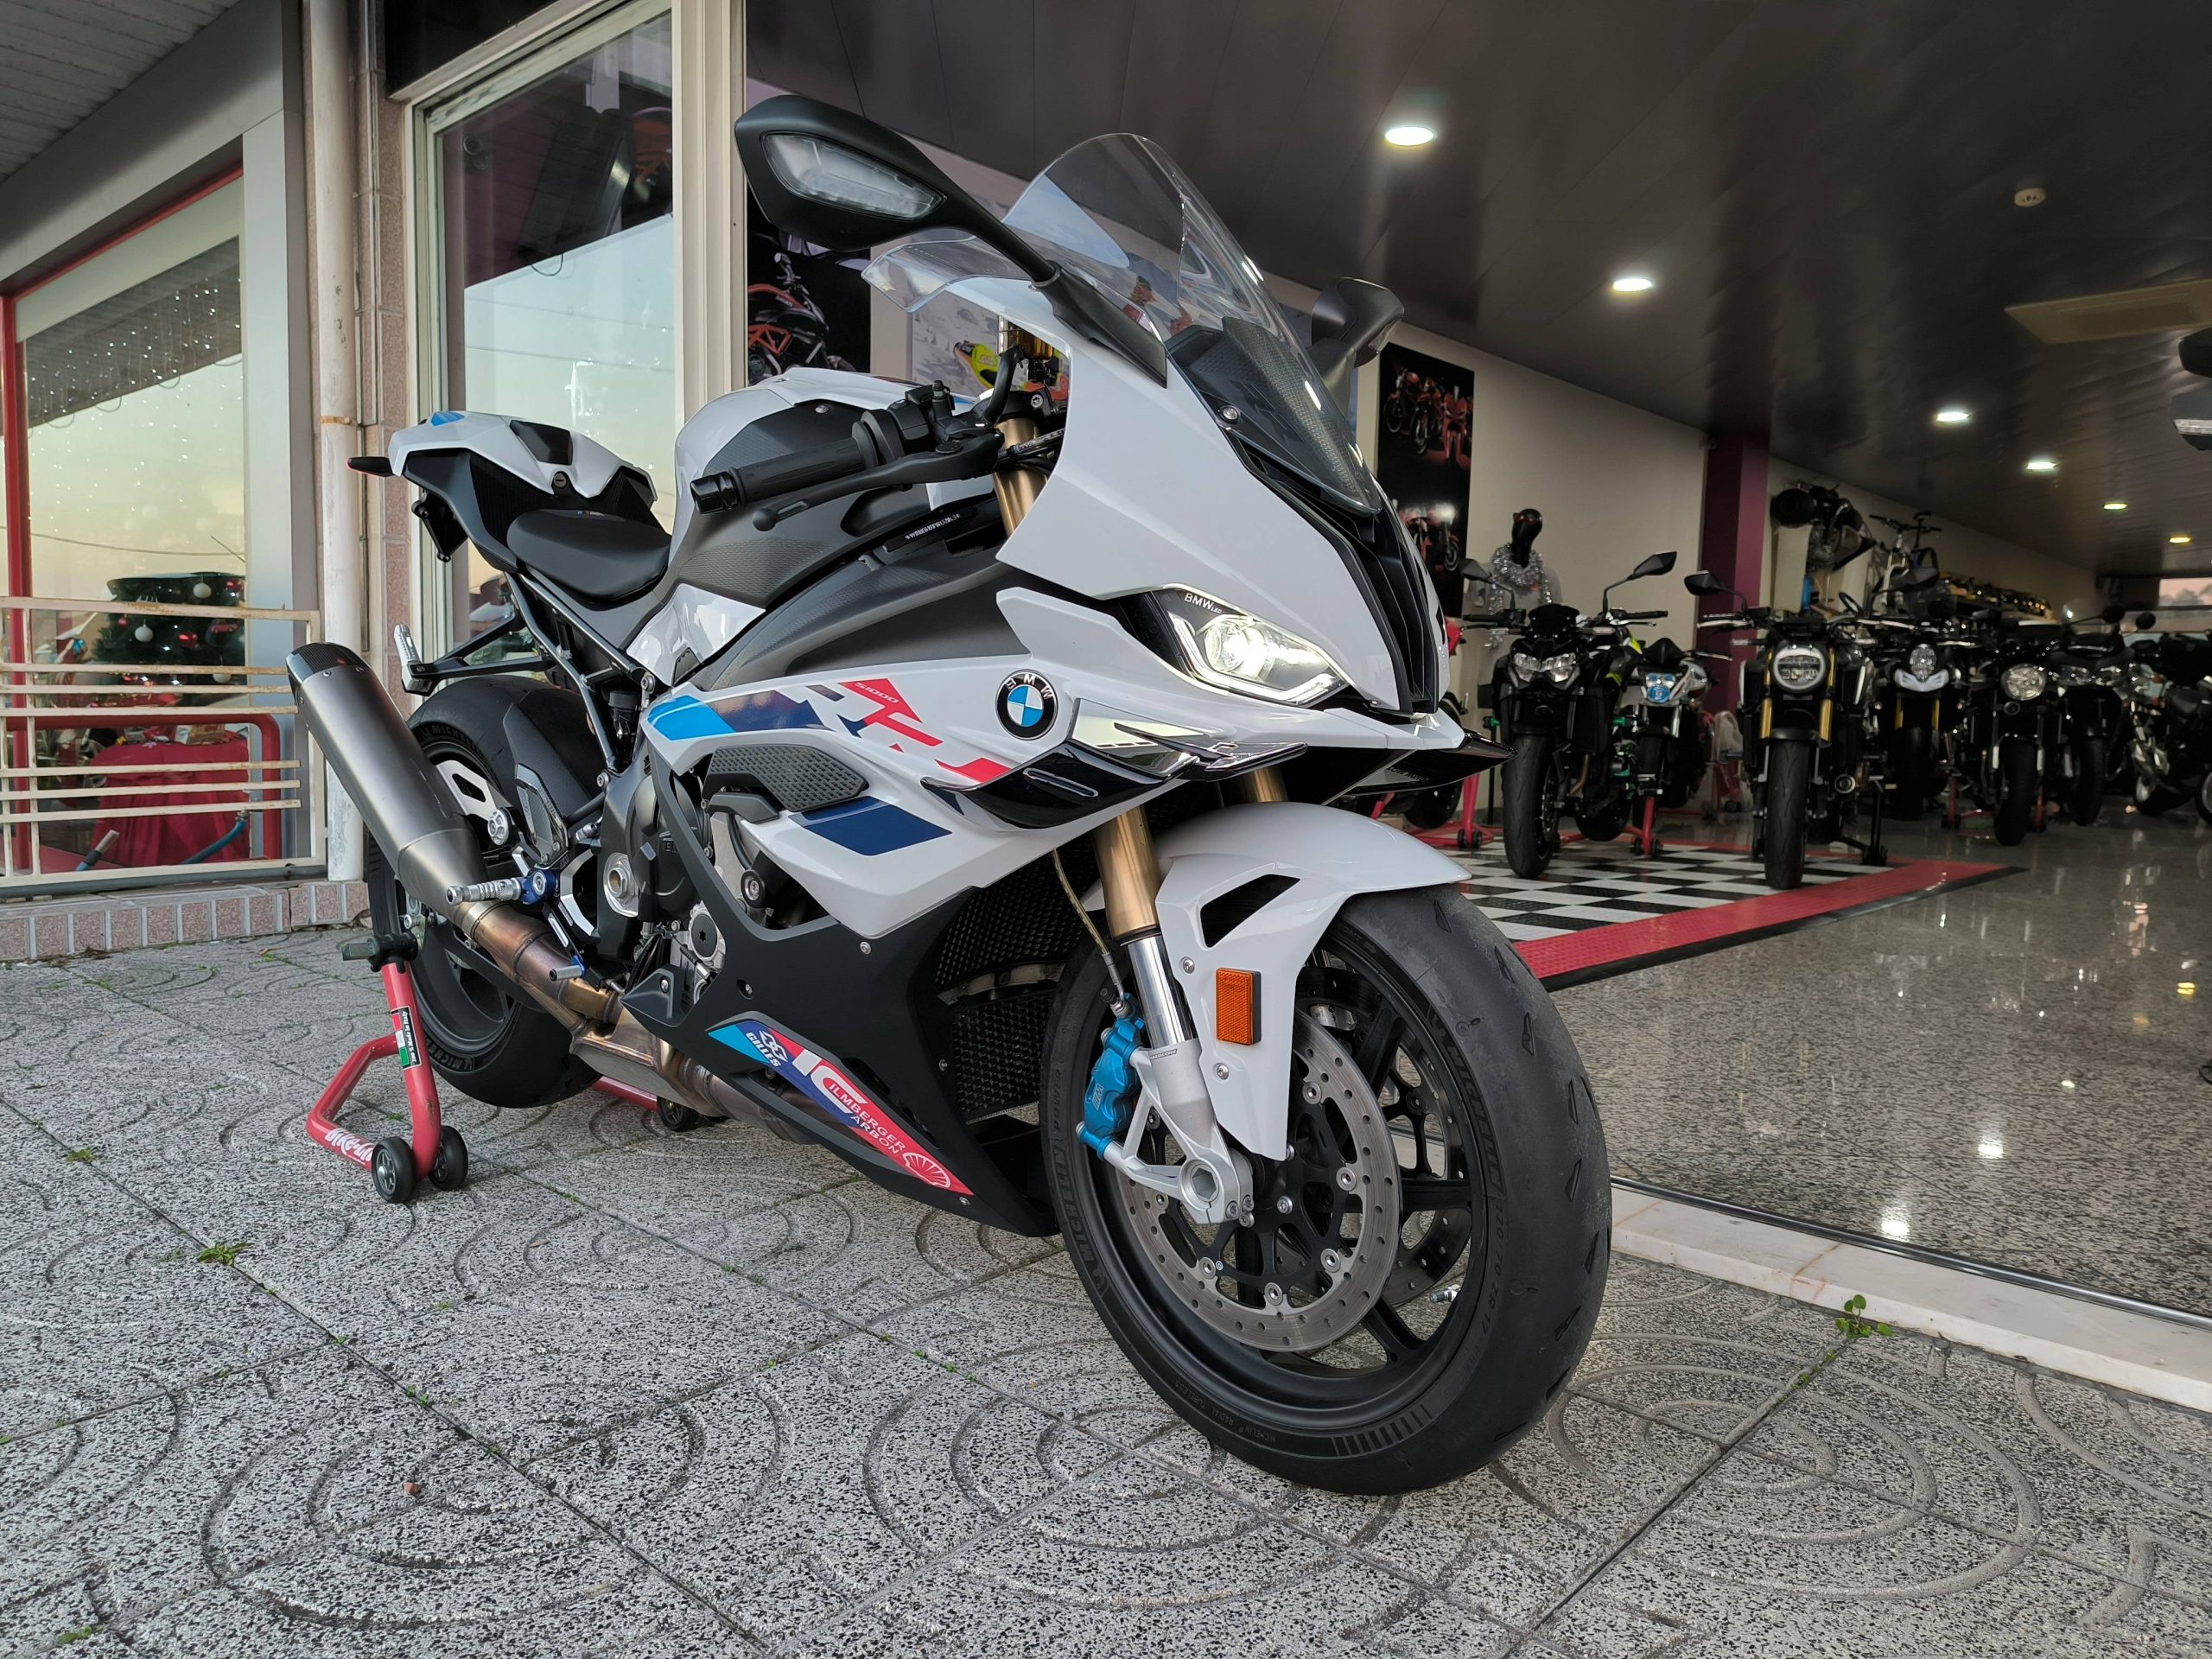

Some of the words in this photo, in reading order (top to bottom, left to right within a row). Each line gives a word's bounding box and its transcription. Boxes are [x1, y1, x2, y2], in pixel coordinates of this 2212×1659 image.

[1184, 593, 1214, 610] BMW
[855, 683, 899, 703] S1000
[746, 1032, 782, 1067] GILLES
[829, 1083, 906, 1152] ILMBERGER
[1053, 1146, 1095, 1262] MICHELIN
[1493, 1205, 1505, 1278] 120/70
[1487, 1281, 1499, 1310] ZR
[1174, 1380, 1207, 1409] TUBELESS
[1211, 1406, 1235, 1426] RADIAL
